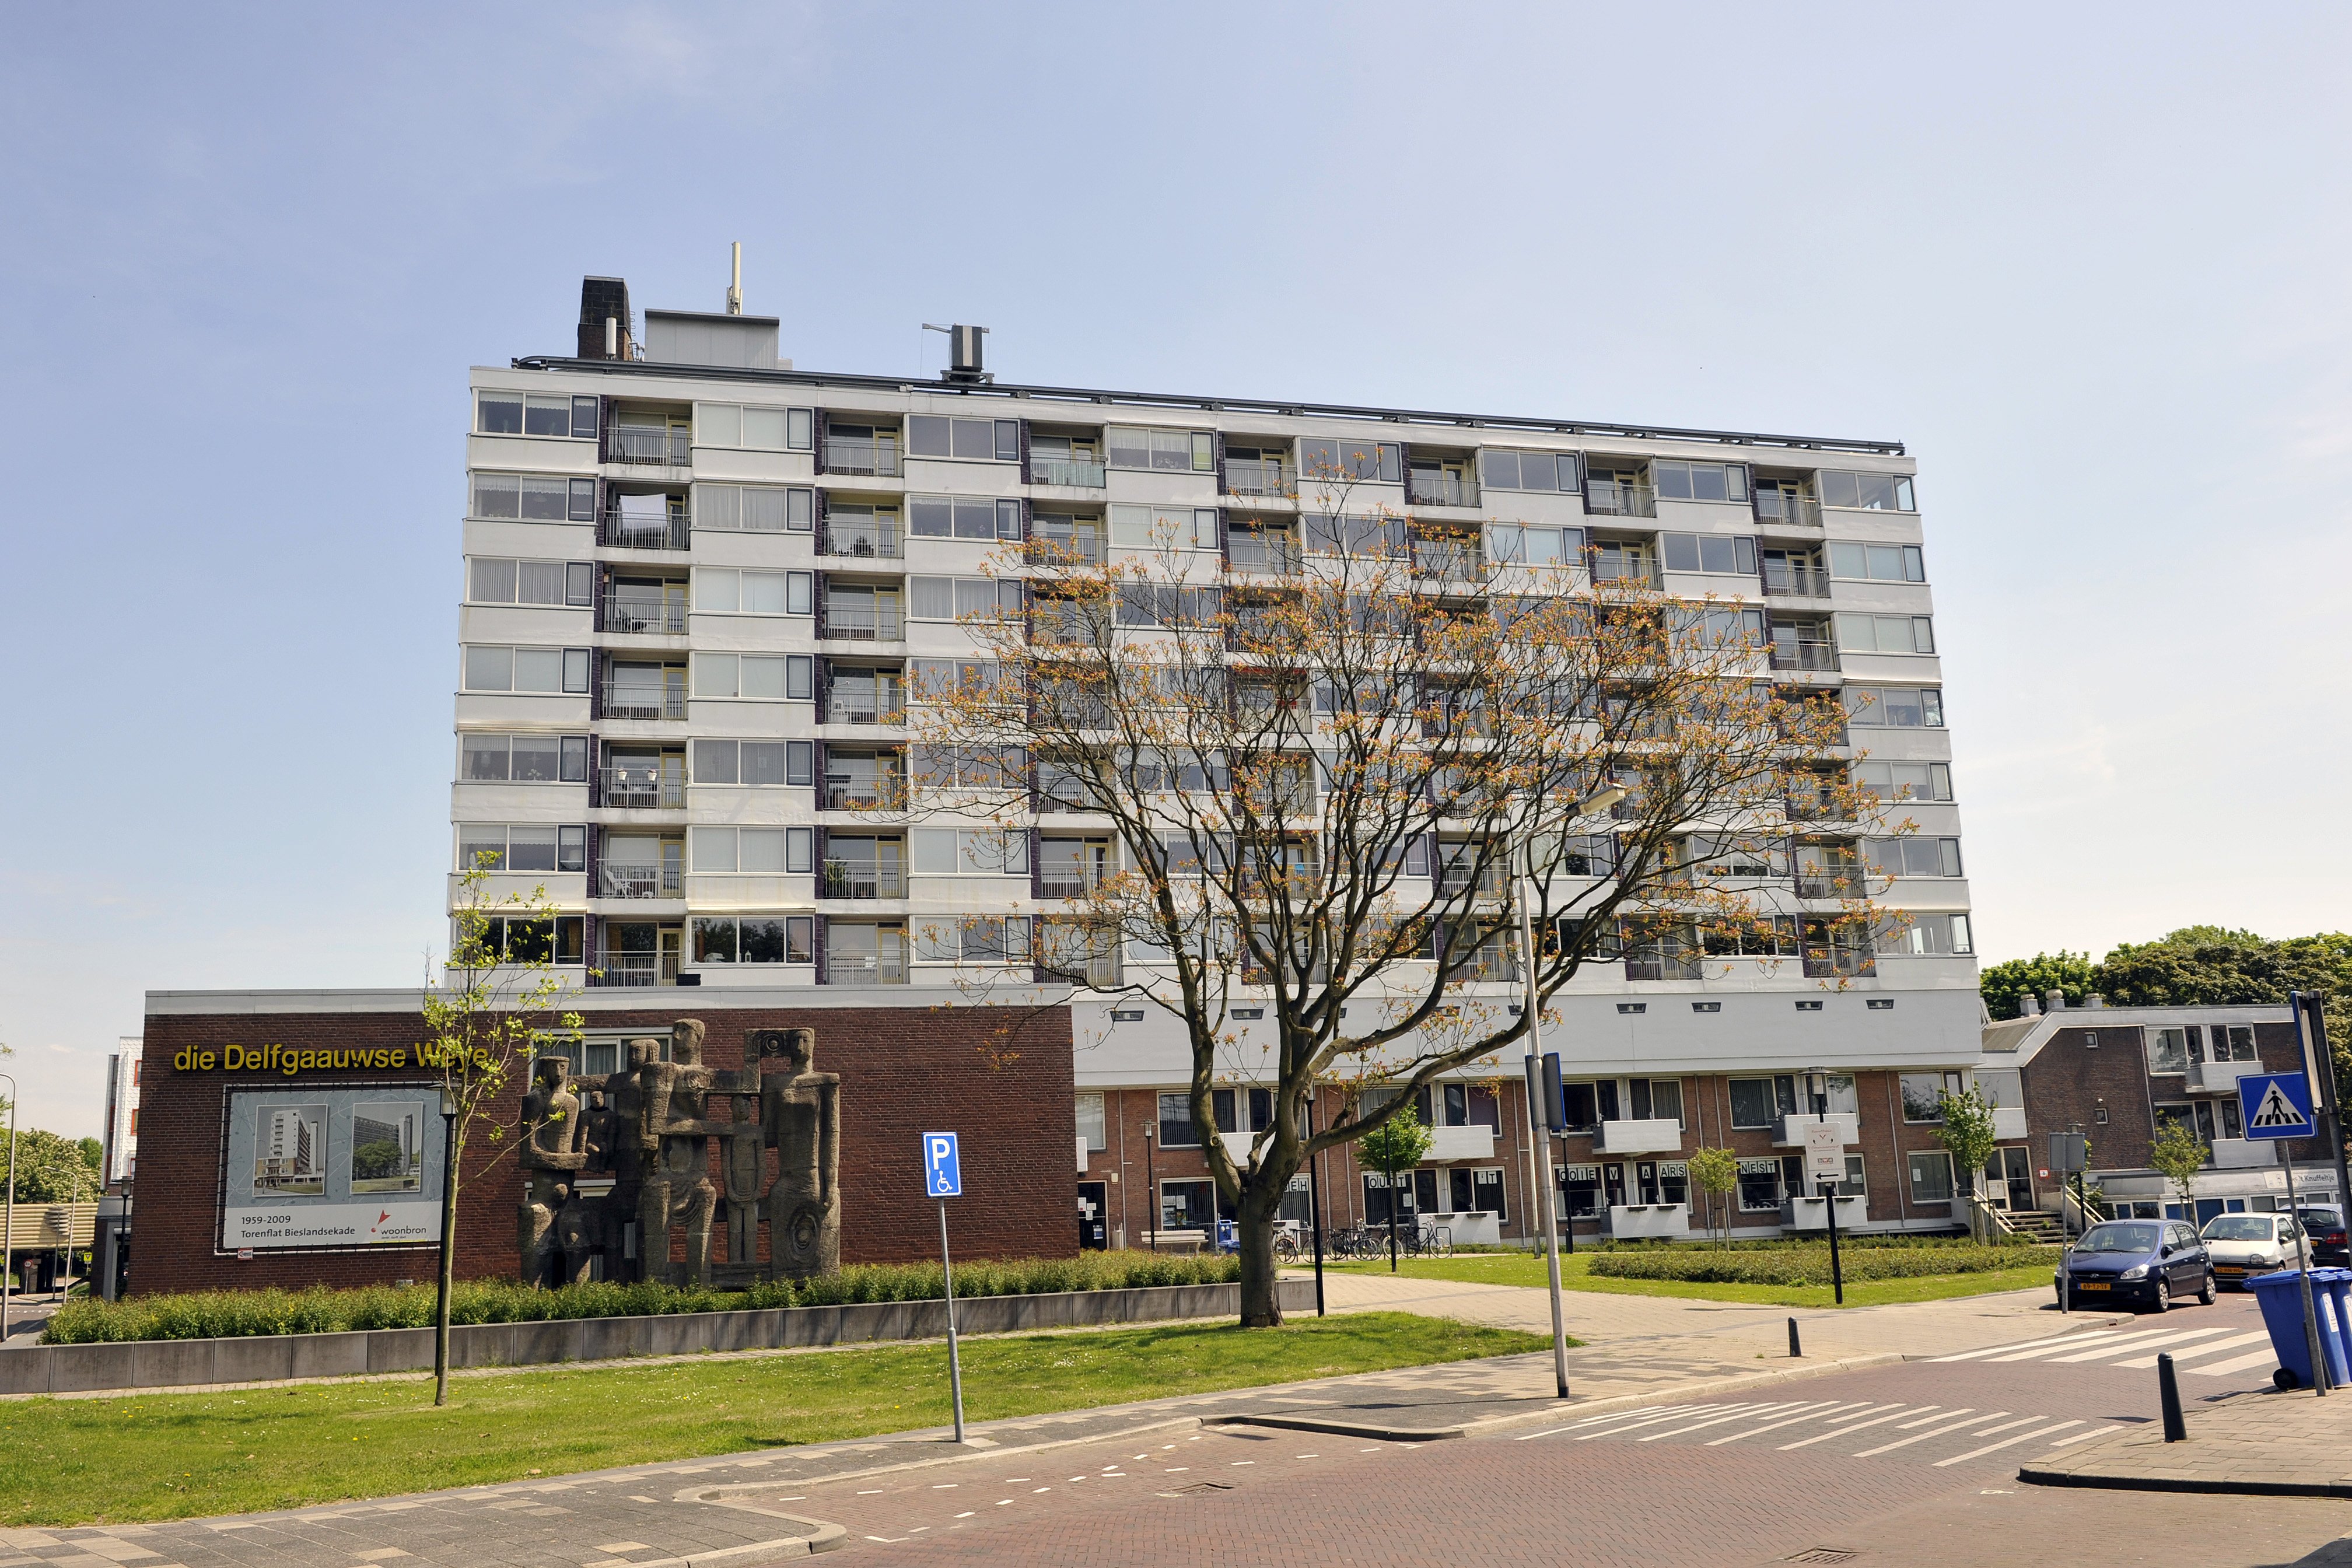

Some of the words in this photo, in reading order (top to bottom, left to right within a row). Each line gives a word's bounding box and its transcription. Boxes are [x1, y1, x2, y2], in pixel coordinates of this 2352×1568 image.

[174, 1045, 215, 1070] die
[225, 1044, 406, 1075] Delfgaauwse
[932, 1139, 950, 1170] P
[1741, 1163, 1773, 1173] NEST
[2305, 1174, 2334, 1182] Knuffeltje
[241, 1215, 291, 1224] 1959-2009
[241, 1228, 282, 1238] Torenflat
[285, 1226, 355, 1237] Bieslandsekade
[380, 1225, 426, 1235] woonbron
